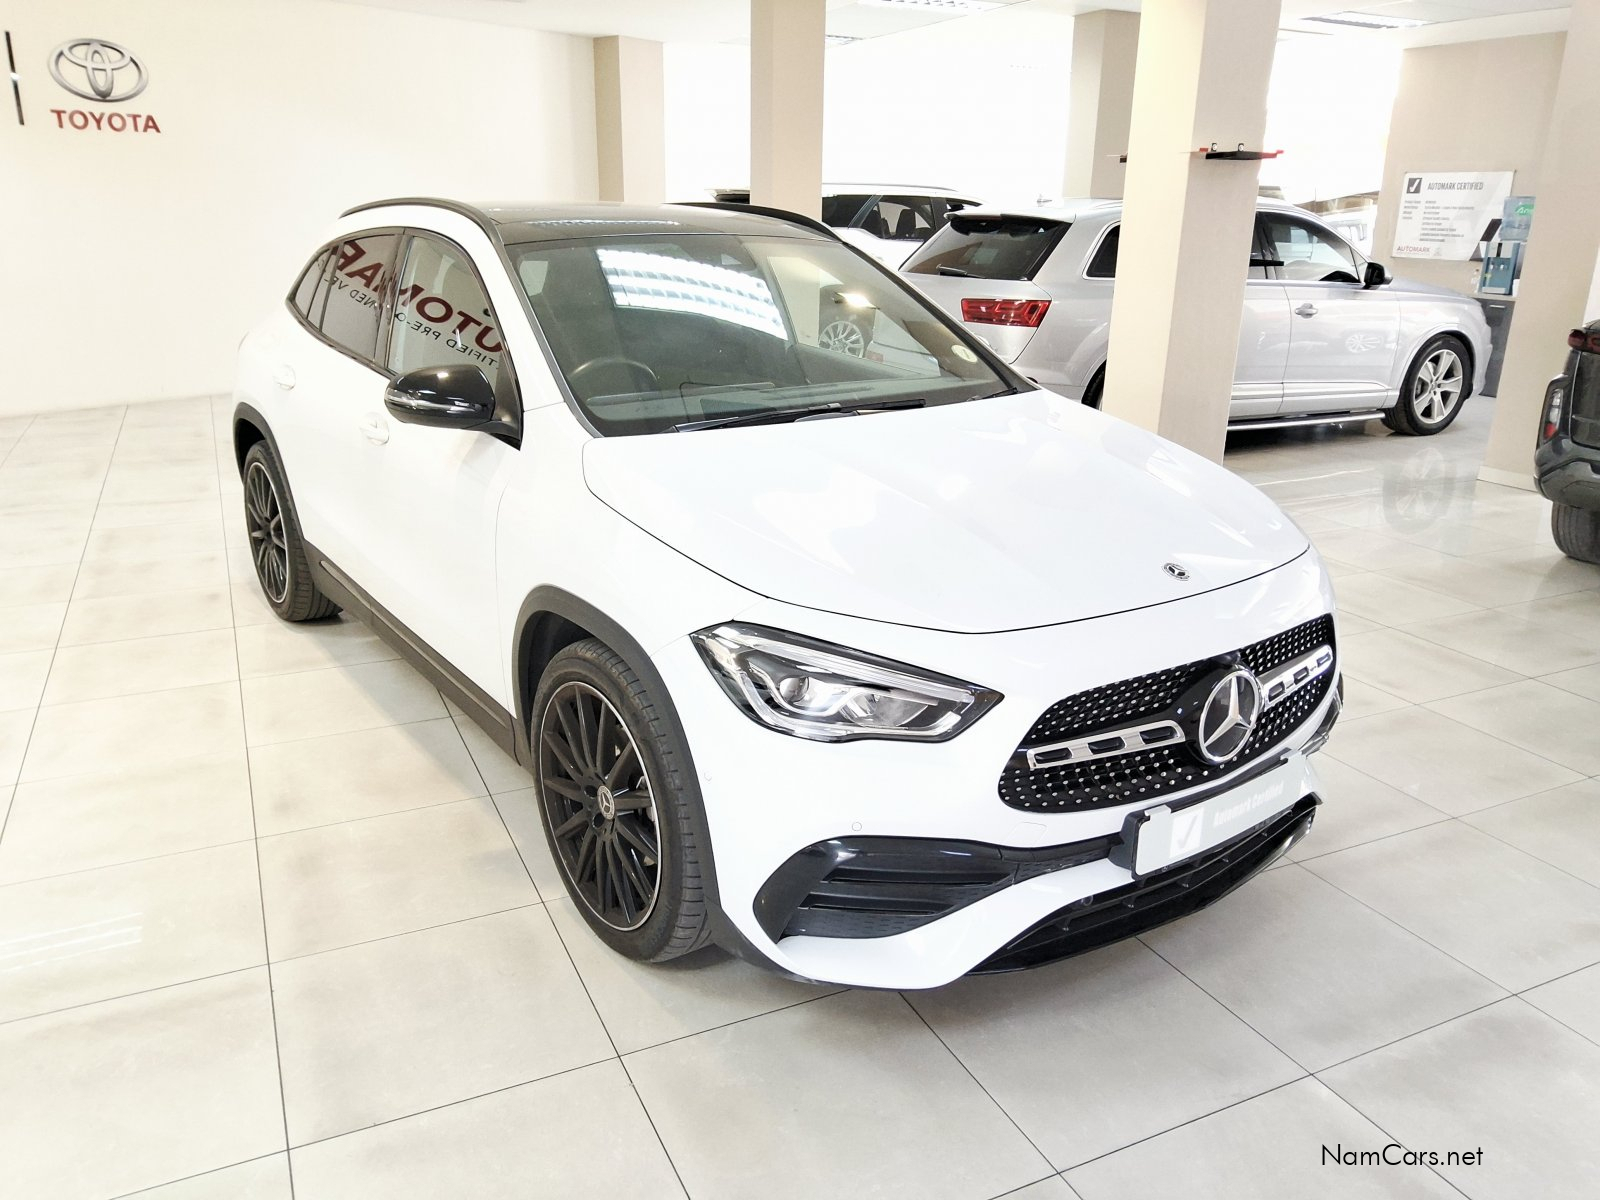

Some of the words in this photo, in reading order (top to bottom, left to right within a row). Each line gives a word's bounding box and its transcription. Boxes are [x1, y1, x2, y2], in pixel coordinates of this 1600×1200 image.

[50, 109, 161, 133] TOYOTA
[1427, 182, 1457, 190] AUTOMARK
[1457, 182, 1484, 190] CERTIFIED
